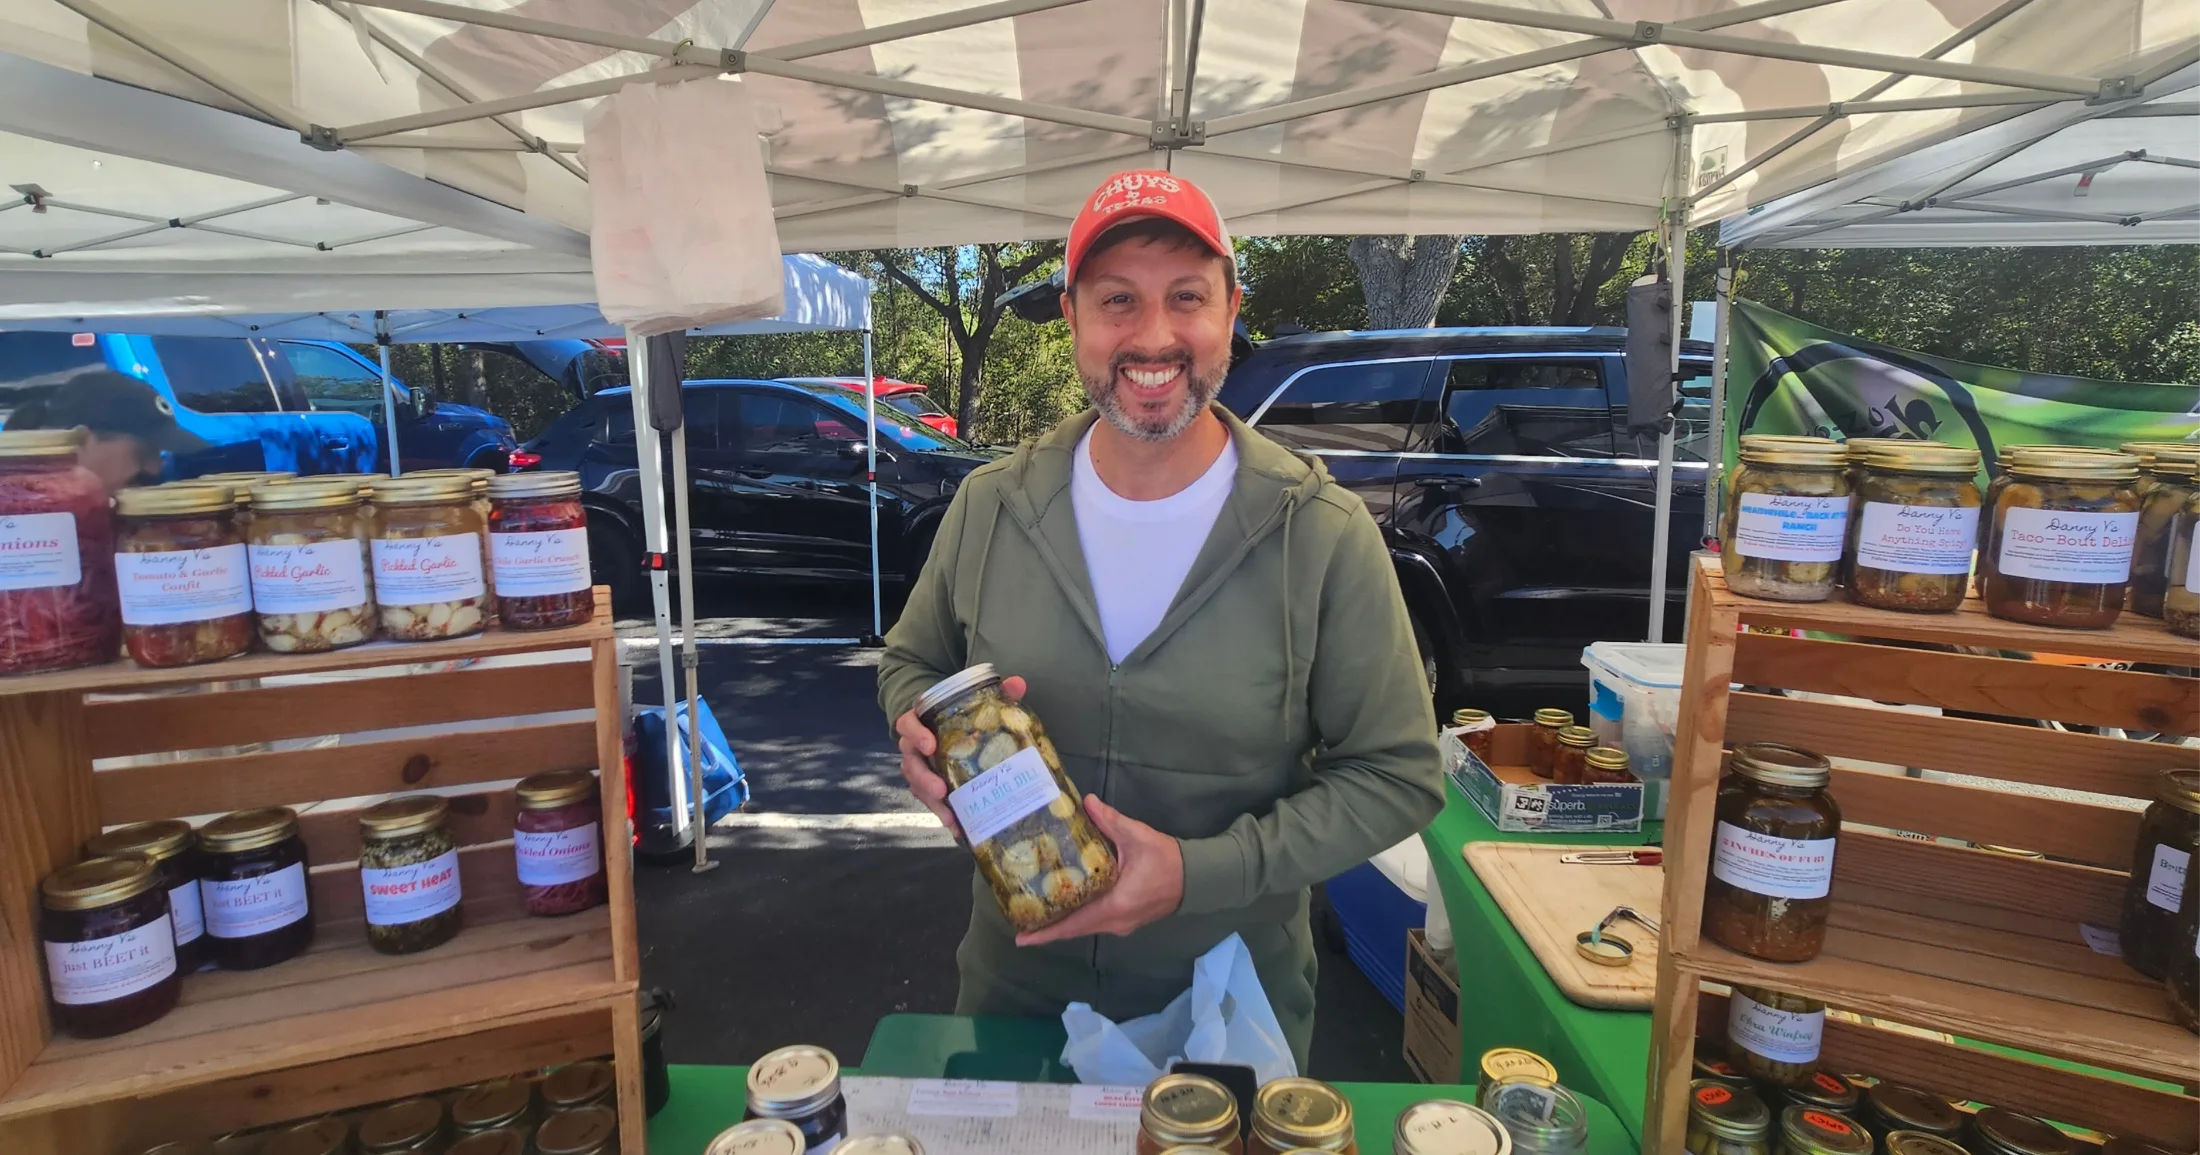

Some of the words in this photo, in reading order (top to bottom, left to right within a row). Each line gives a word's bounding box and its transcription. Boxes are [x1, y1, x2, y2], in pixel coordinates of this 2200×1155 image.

[1769, 496, 1813, 516] Danny
[1782, 521, 1817, 531] RANCH
[1897, 506, 1945, 527] Danny
[1897, 523, 1911, 532] Do
[1914, 525, 1935, 534] You
[1938, 527, 1962, 535] Have
[2046, 517, 2098, 540] Danny
[0, 537, 60, 552] nions
[384, 538, 420, 557] Danny
[504, 536, 543, 553] Danny
[1881, 534, 1937, 548] Anything
[140, 551, 188, 570] Danny
[256, 545, 292, 564] Danny
[514, 554, 545, 565] Garlic
[132, 571, 176, 581] Tomato
[179, 569, 188, 578] &
[192, 566, 228, 577] Garlic
[290, 563, 332, 582] Garlic
[381, 558, 417, 572] Pickled
[420, 555, 457, 574] Garlic
[161, 580, 200, 591] Confit
[971, 772, 1000, 793] Danny
[981, 796, 992, 808] A
[991, 782, 1013, 800] BIG
[548, 841, 591, 856] Onions
[1730, 839, 1776, 859] INCHES
[1799, 855, 1825, 863] FURY
[1745, 831, 1785, 853] Danny
[370, 881, 417, 896] SWEET
[420, 867, 452, 889] HEAT
[383, 867, 418, 881] Danny
[216, 881, 250, 895] Danny
[234, 891, 269, 907] BEET
[274, 888, 282, 898] it
[68, 942, 114, 956] Danny
[63, 959, 88, 974] just
[93, 948, 136, 970] BEET
[140, 944, 150, 957] it
[1752, 1003, 1787, 1024] Danny
[1768, 1025, 1813, 1041] Winfrey
[1703, 1088, 1727, 1102] SPICY
[1809, 1114, 1845, 1131] SPICY
